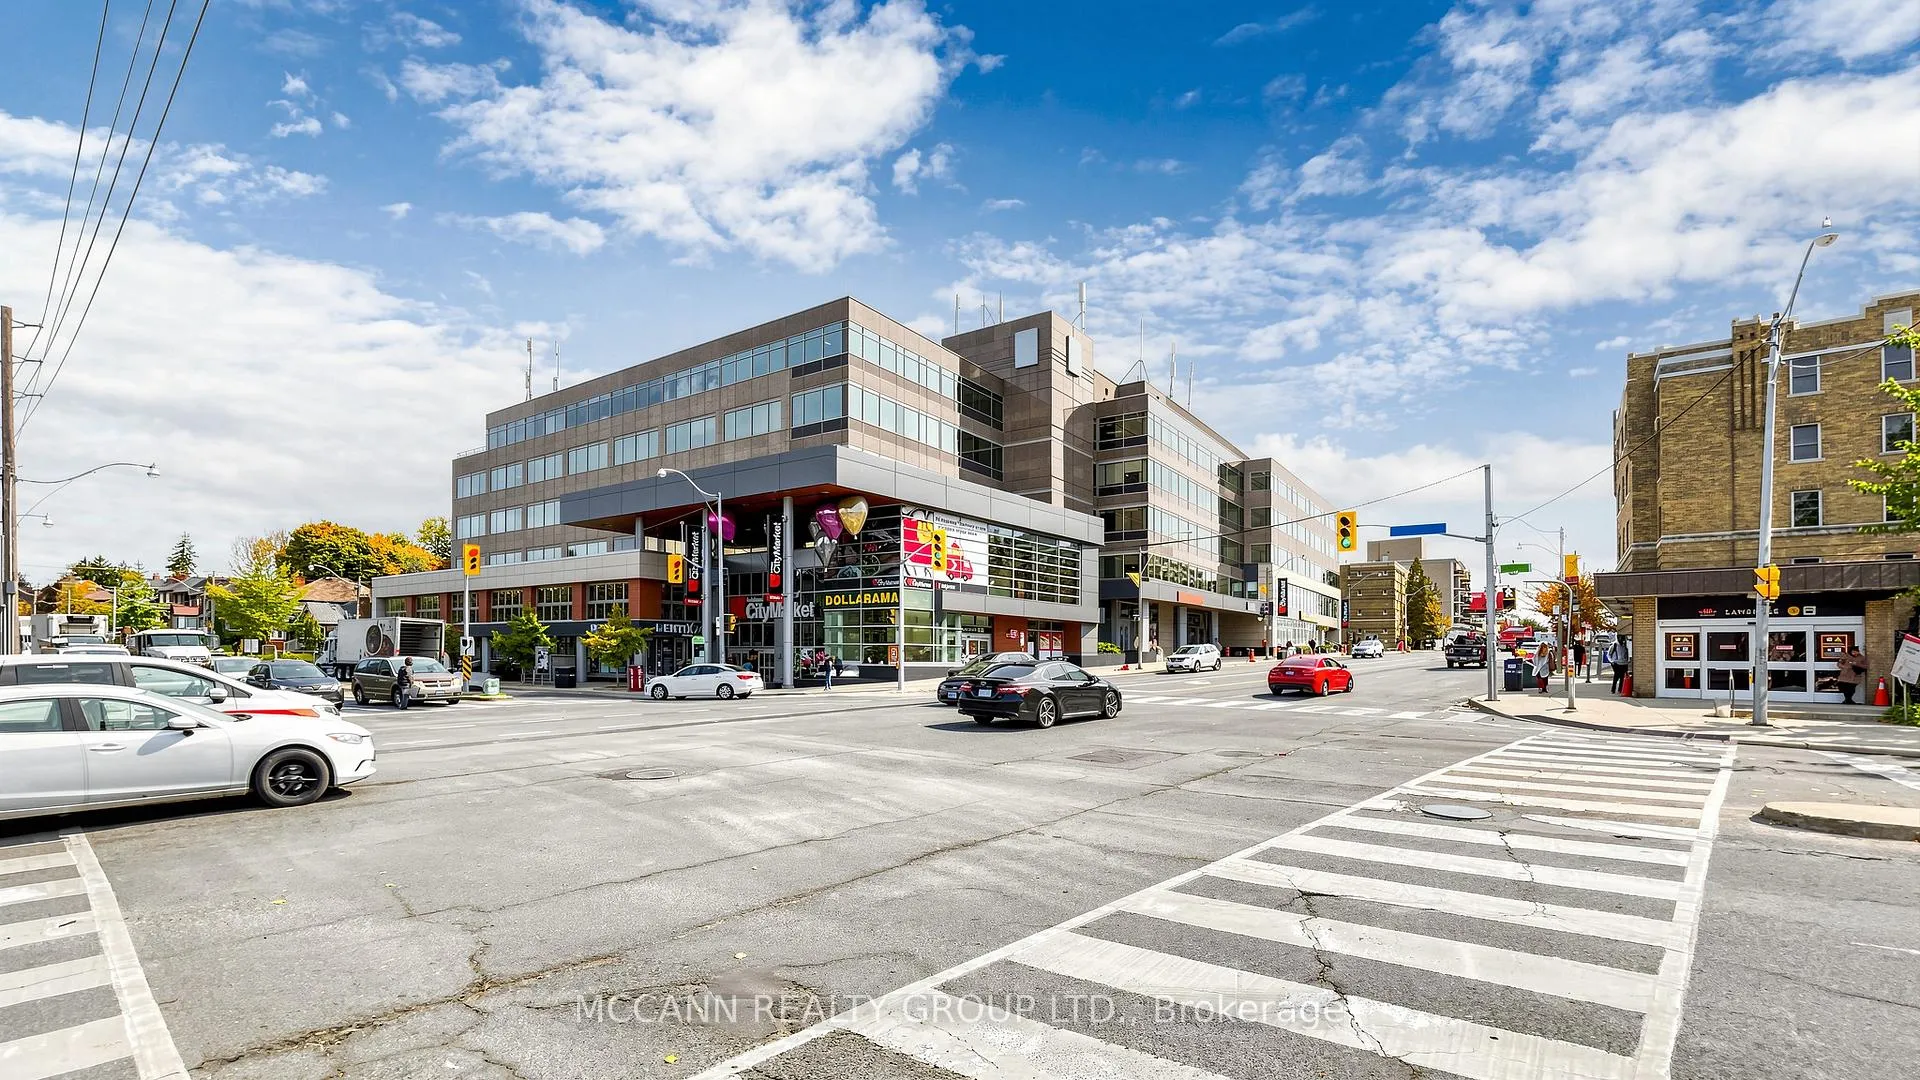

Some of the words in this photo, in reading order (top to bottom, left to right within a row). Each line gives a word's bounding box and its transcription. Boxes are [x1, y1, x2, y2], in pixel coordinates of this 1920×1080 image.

[773, 521, 783, 574] CityMarket
[825, 592, 899, 606] DOLLARAMA
[745, 601, 815, 623] CityMket
